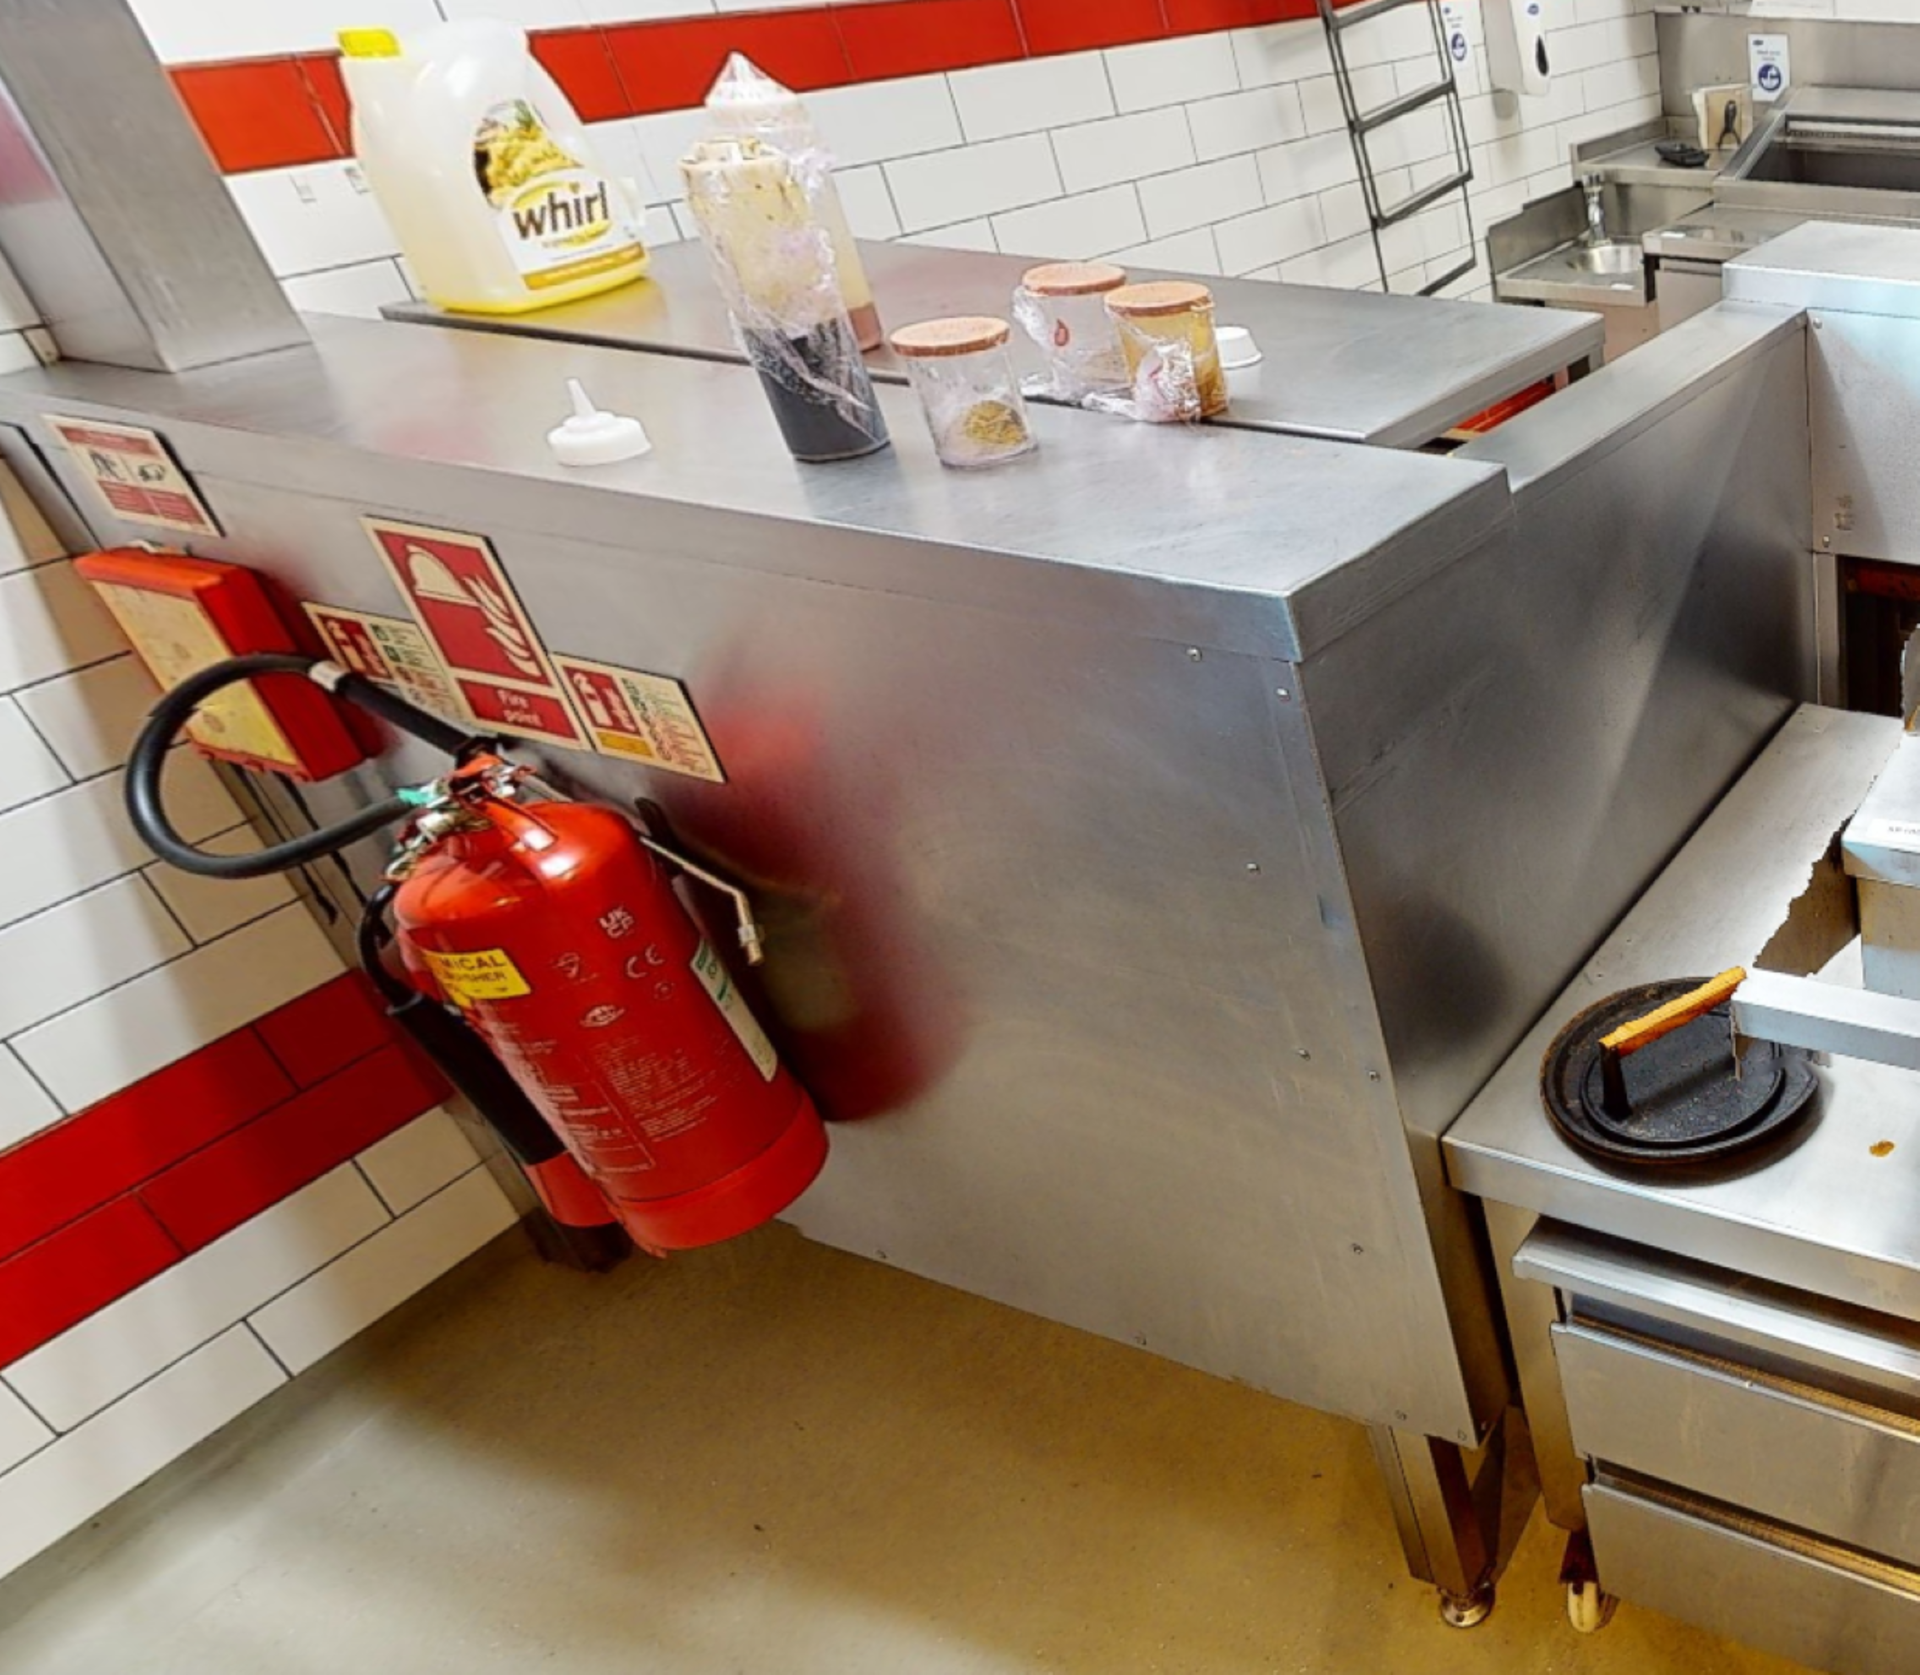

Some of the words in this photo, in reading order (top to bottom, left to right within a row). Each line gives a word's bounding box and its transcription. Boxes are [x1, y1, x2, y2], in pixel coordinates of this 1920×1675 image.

[513, 180, 610, 240] whirl
[497, 688, 529, 709] Fire
[502, 709, 544, 728] point
